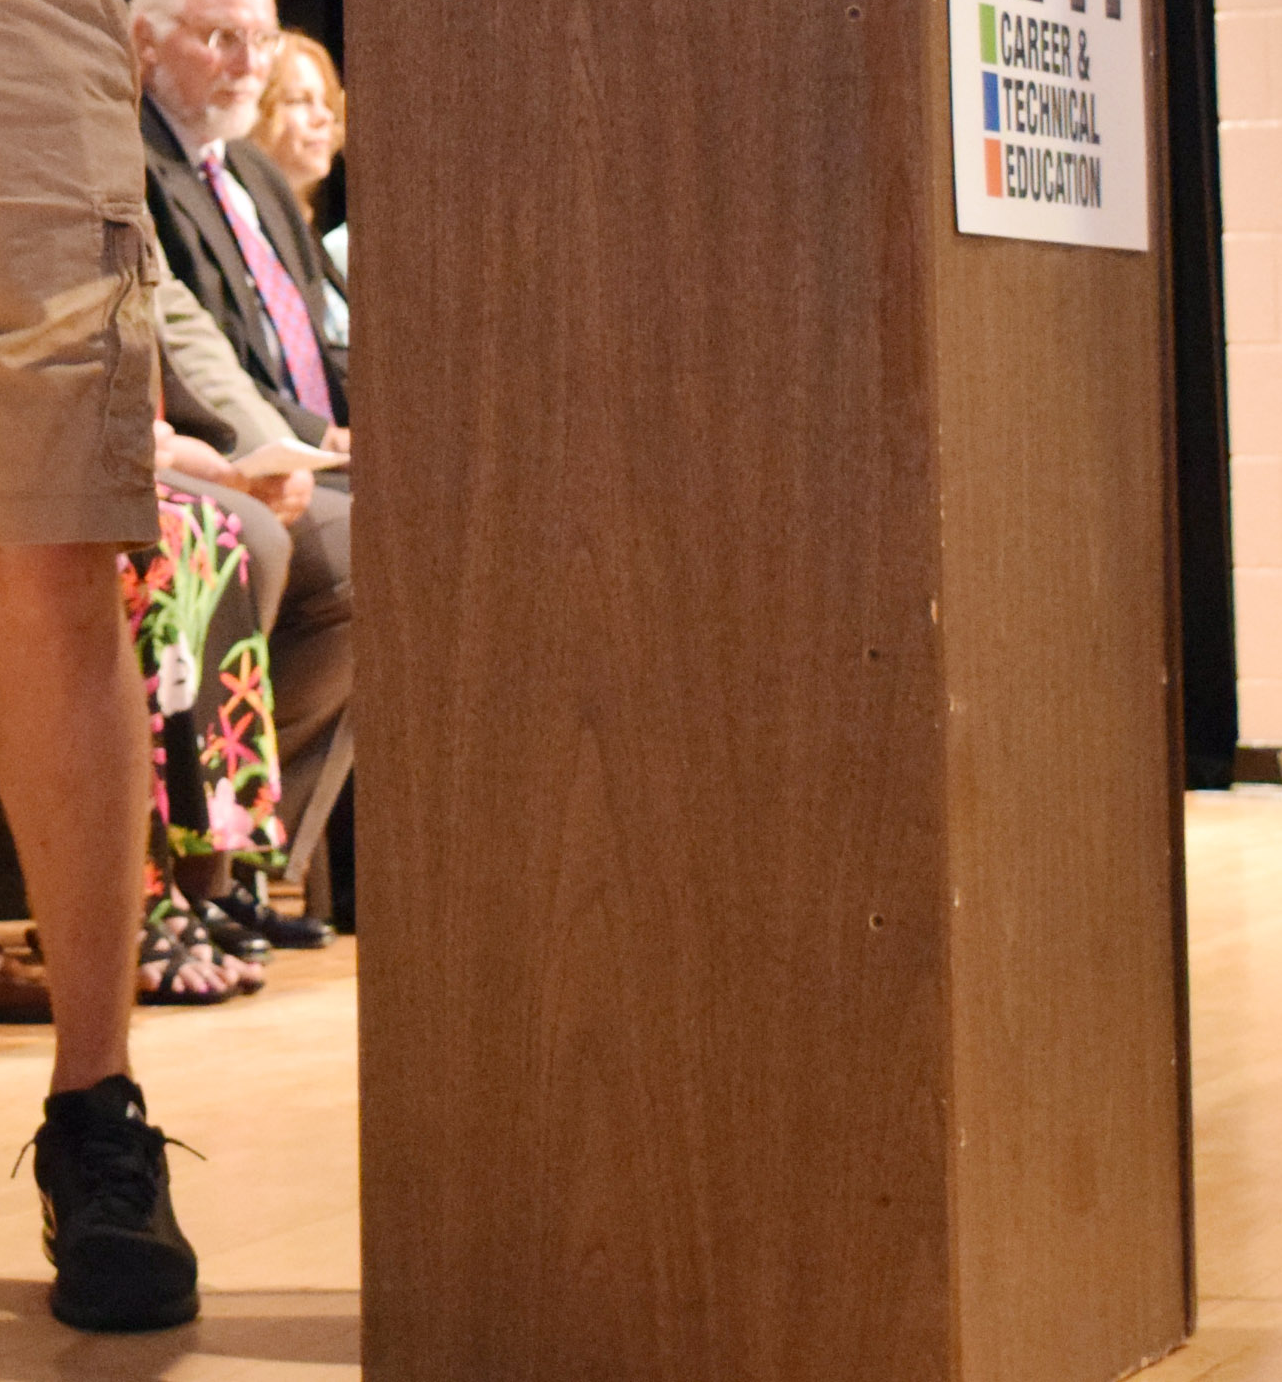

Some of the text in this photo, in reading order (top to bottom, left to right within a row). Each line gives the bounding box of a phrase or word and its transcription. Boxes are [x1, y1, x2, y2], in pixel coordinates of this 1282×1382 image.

[1001, 11, 1091, 81] CAREER &
[1002, 77, 1100, 145] TECHNICAL
[1006, 144, 1101, 208] EDUCATION
